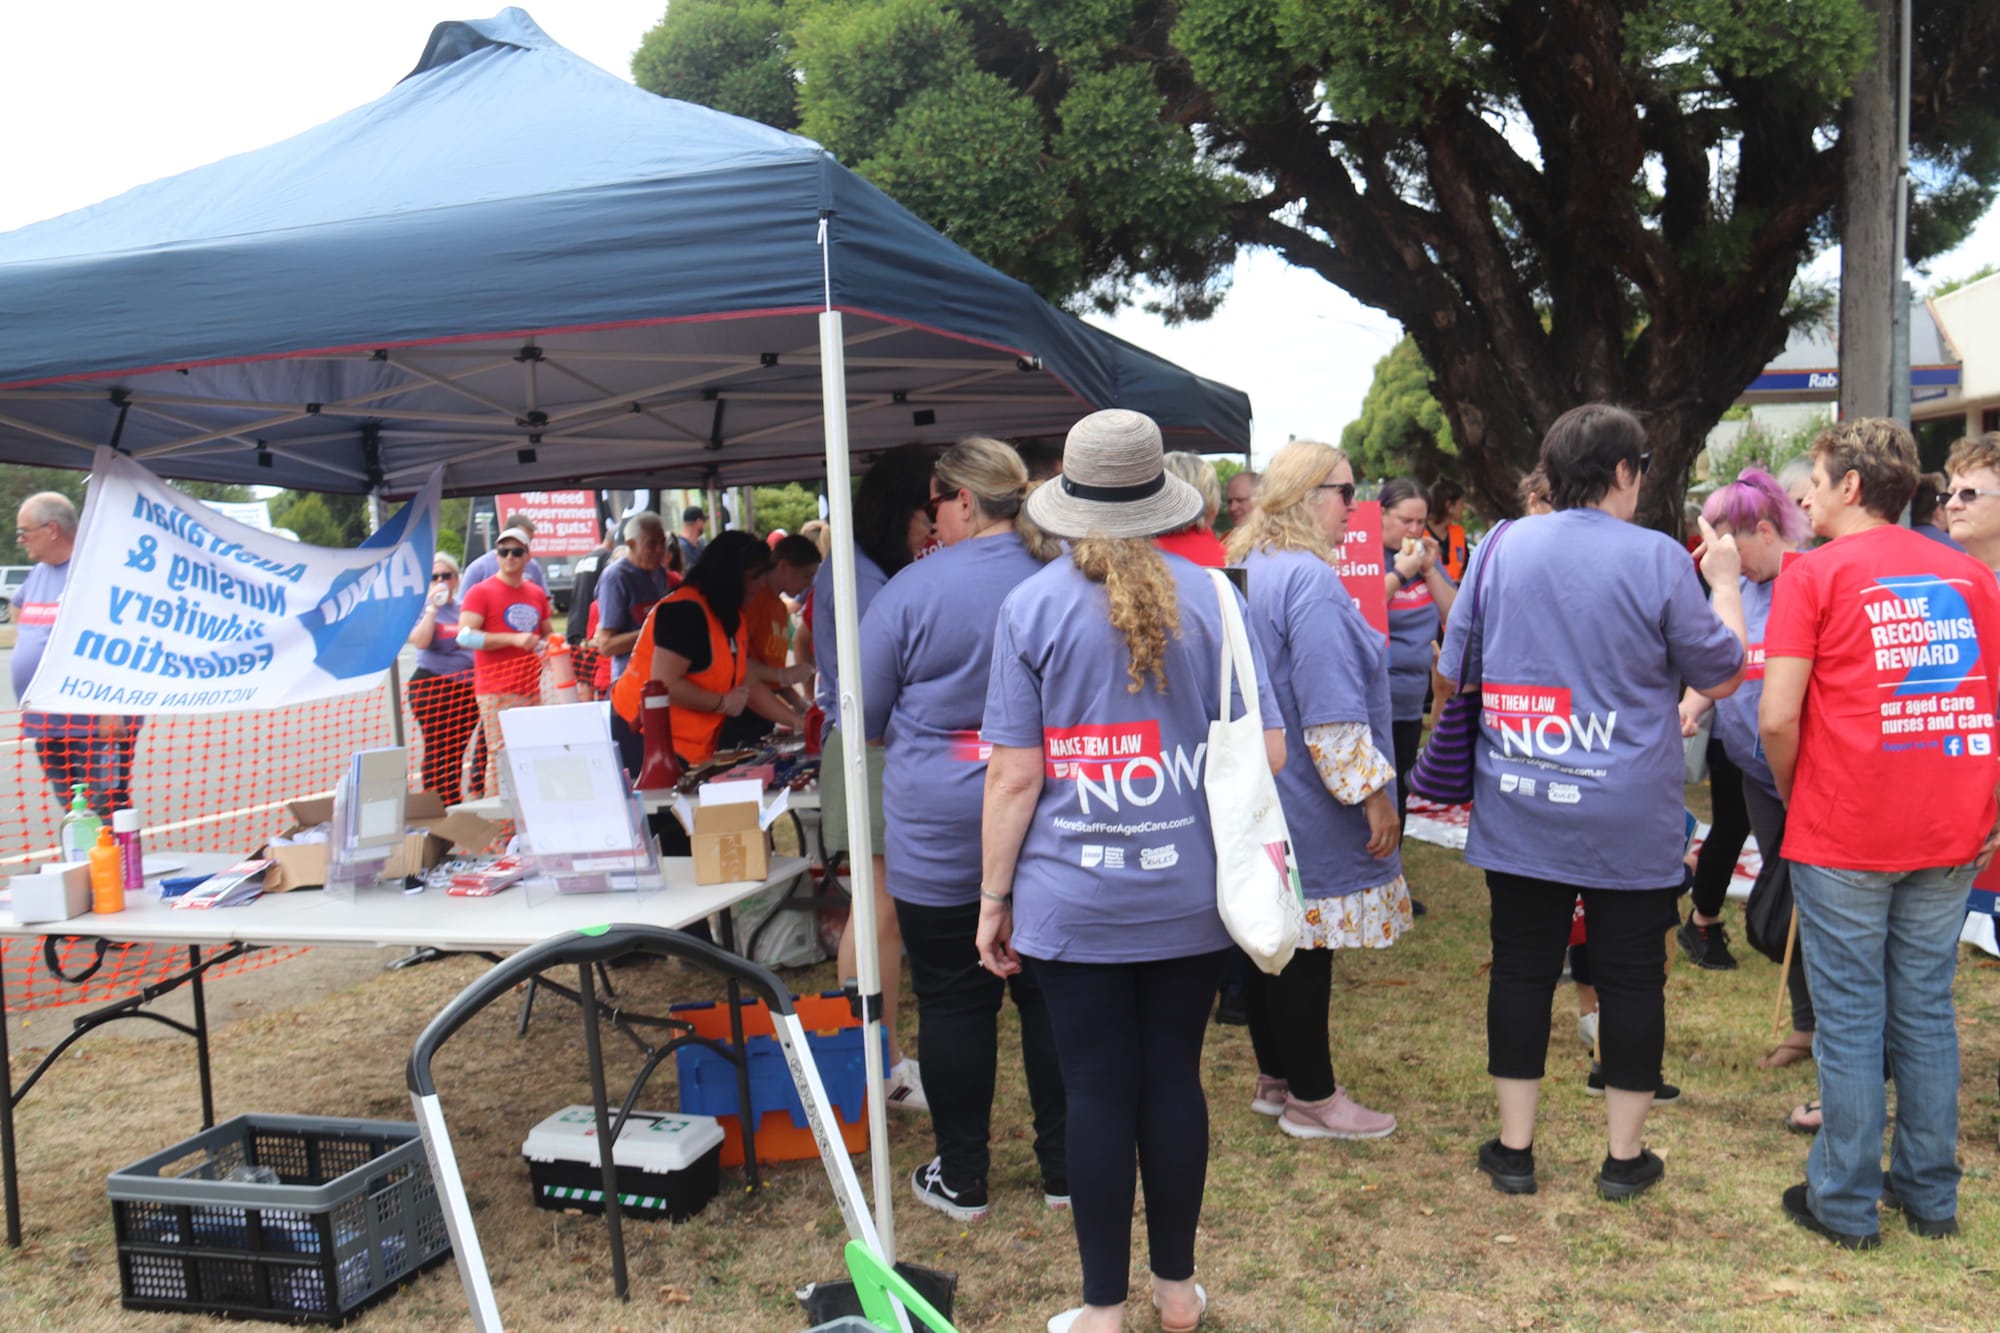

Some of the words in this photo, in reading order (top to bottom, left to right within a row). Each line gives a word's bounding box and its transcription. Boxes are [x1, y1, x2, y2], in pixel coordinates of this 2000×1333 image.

[551, 491, 585, 504] need
[1864, 597, 1931, 625] VALUE
[1875, 643, 1960, 672] REWARD
[1500, 693, 1529, 711] THEM
[1531, 695, 1556, 713] LAW
[1880, 702, 1902, 717] our
[1905, 696, 1937, 717] aged
[1940, 696, 1975, 712] care
[1500, 710, 1617, 758] NOW
[1882, 717, 1924, 735] nurses
[1927, 713, 1955, 731] and
[1050, 736, 1082, 758] MAKE
[1112, 734, 1142, 755] LAW
[1077, 742, 1209, 815] NOW
